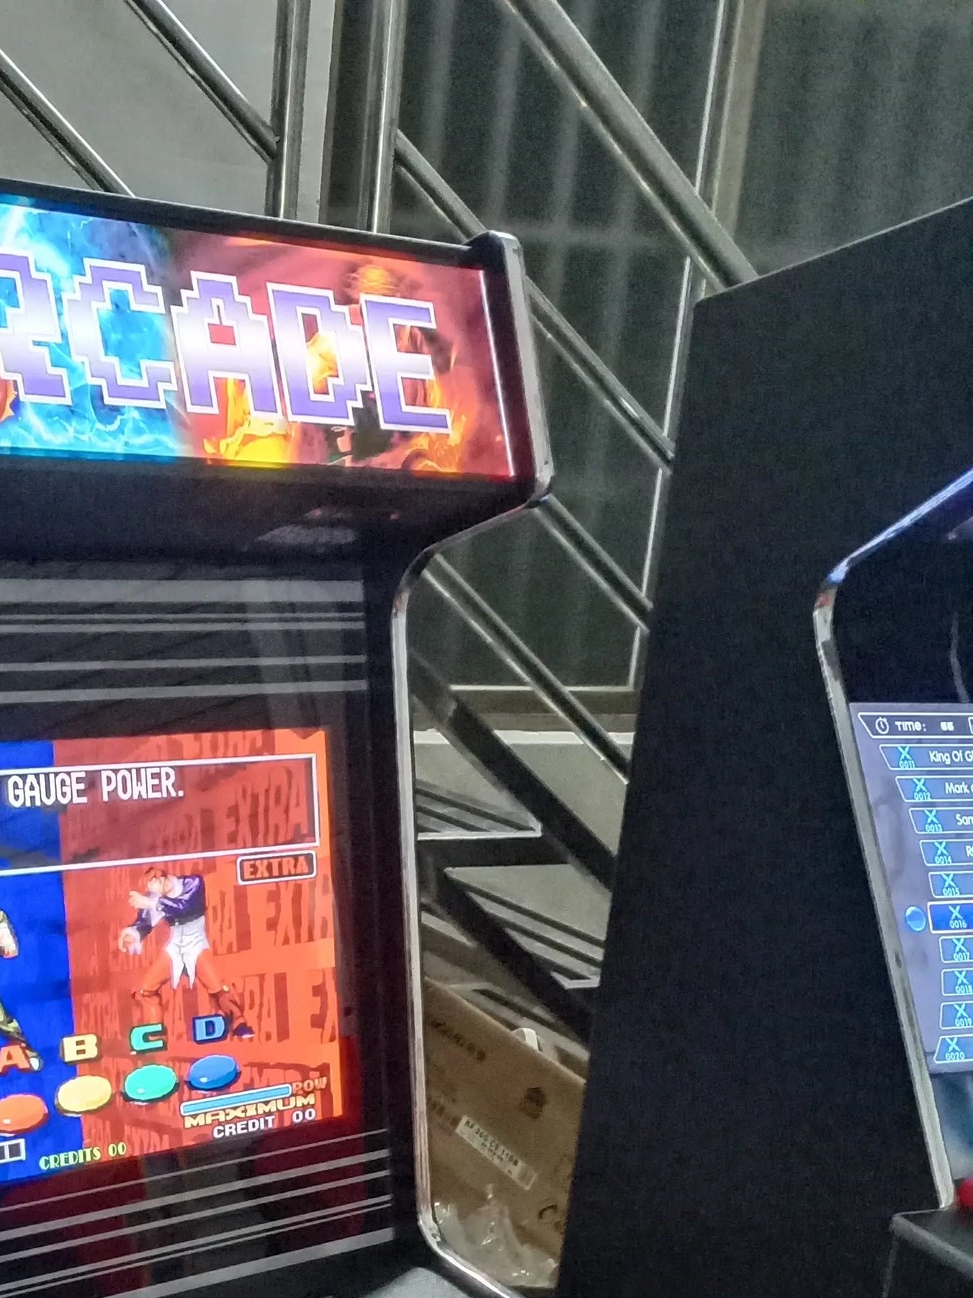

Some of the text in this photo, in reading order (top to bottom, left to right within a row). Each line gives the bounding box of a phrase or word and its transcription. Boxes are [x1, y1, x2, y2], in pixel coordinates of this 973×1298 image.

[929, 750, 951, 765] King
[952, 750, 964, 762] Of
[7, 772, 88, 808] GAUGE
[101, 766, 185, 802] POWER.
[945, 782, 968, 794] Mark
[925, 824, 943, 832] 0013
[934, 856, 953, 865] 0014
[244, 857, 309, 880] EXTRA
[942, 888, 960, 896] 0015
[949, 920, 967, 929] 0016
[953, 952, 970, 961] 0017
[955, 985, 973, 994] 0018
[193, 1014, 226, 1043] D
[955, 1018, 973, 1027] 0019
[129, 1023, 164, 1052] C
[60, 1033, 99, 1062] B
[945, 1052, 965, 1061] 0020
[291, 1077, 328, 1094] POW
[184, 1093, 316, 1129] MAXIMUM
[213, 1107, 316, 1139] CREDIT 00
[38, 1142, 127, 1171] CREDITS 00
